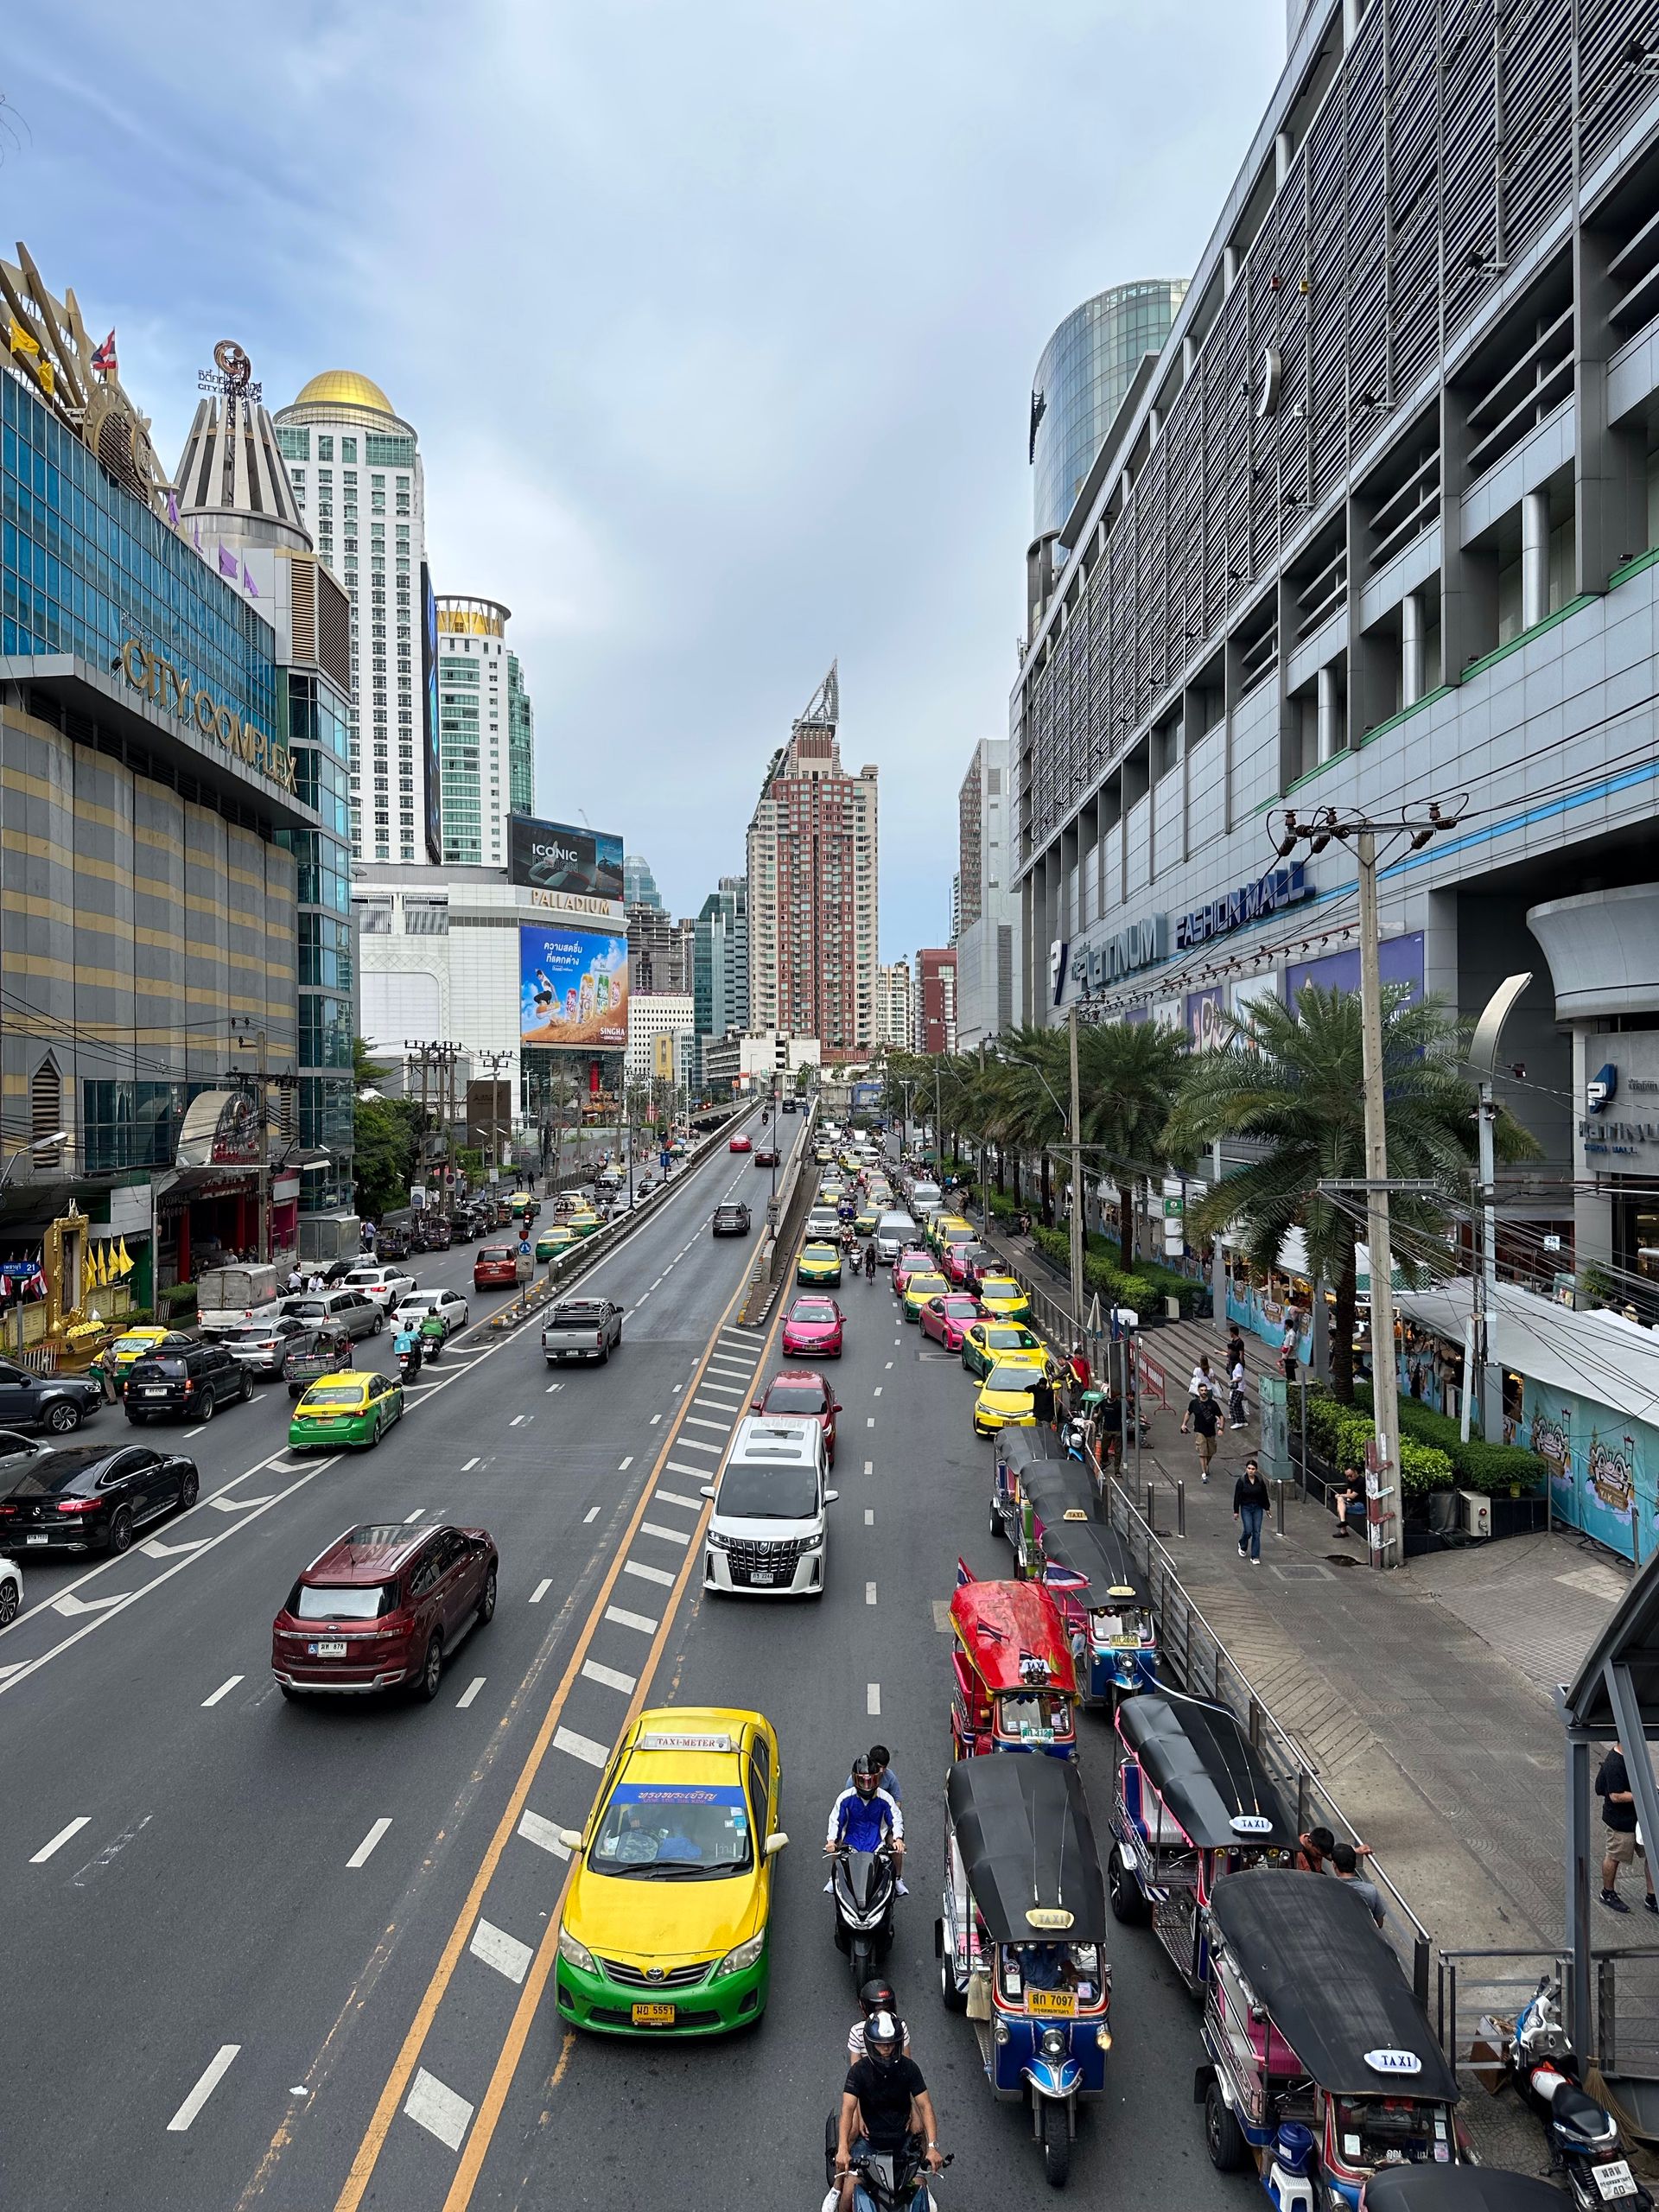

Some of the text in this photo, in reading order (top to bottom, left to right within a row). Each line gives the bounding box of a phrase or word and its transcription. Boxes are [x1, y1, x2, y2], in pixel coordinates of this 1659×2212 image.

[198, 383, 218, 392] CITY
[123, 639, 297, 793] CITY COMPLEX
[532, 843, 578, 862] ICONIC
[531, 890, 610, 915] PALLADIUM
[1175, 861, 1316, 950] FASHION MALL
[543, 941, 583, 954] ความสดชื่น
[546, 950, 580, 966] ที่แตกต่าง
[600, 1027, 625, 1036] SINGHA
[27, 1263, 35, 1272] 21
[657, 1738, 715, 1747] TAXI-METER
[638, 1790, 718, 1802] ทรงพระเจริญ
[1242, 1819, 1265, 1828] TAXI
[1038, 1914, 1065, 1924] TAXI
[1032, 1993, 1073, 2007] สก 7097
[653, 2005, 673, 2015] 5551
[1382, 2055, 1412, 2068] TAXI
[1613, 2185, 1626, 2196] 40
